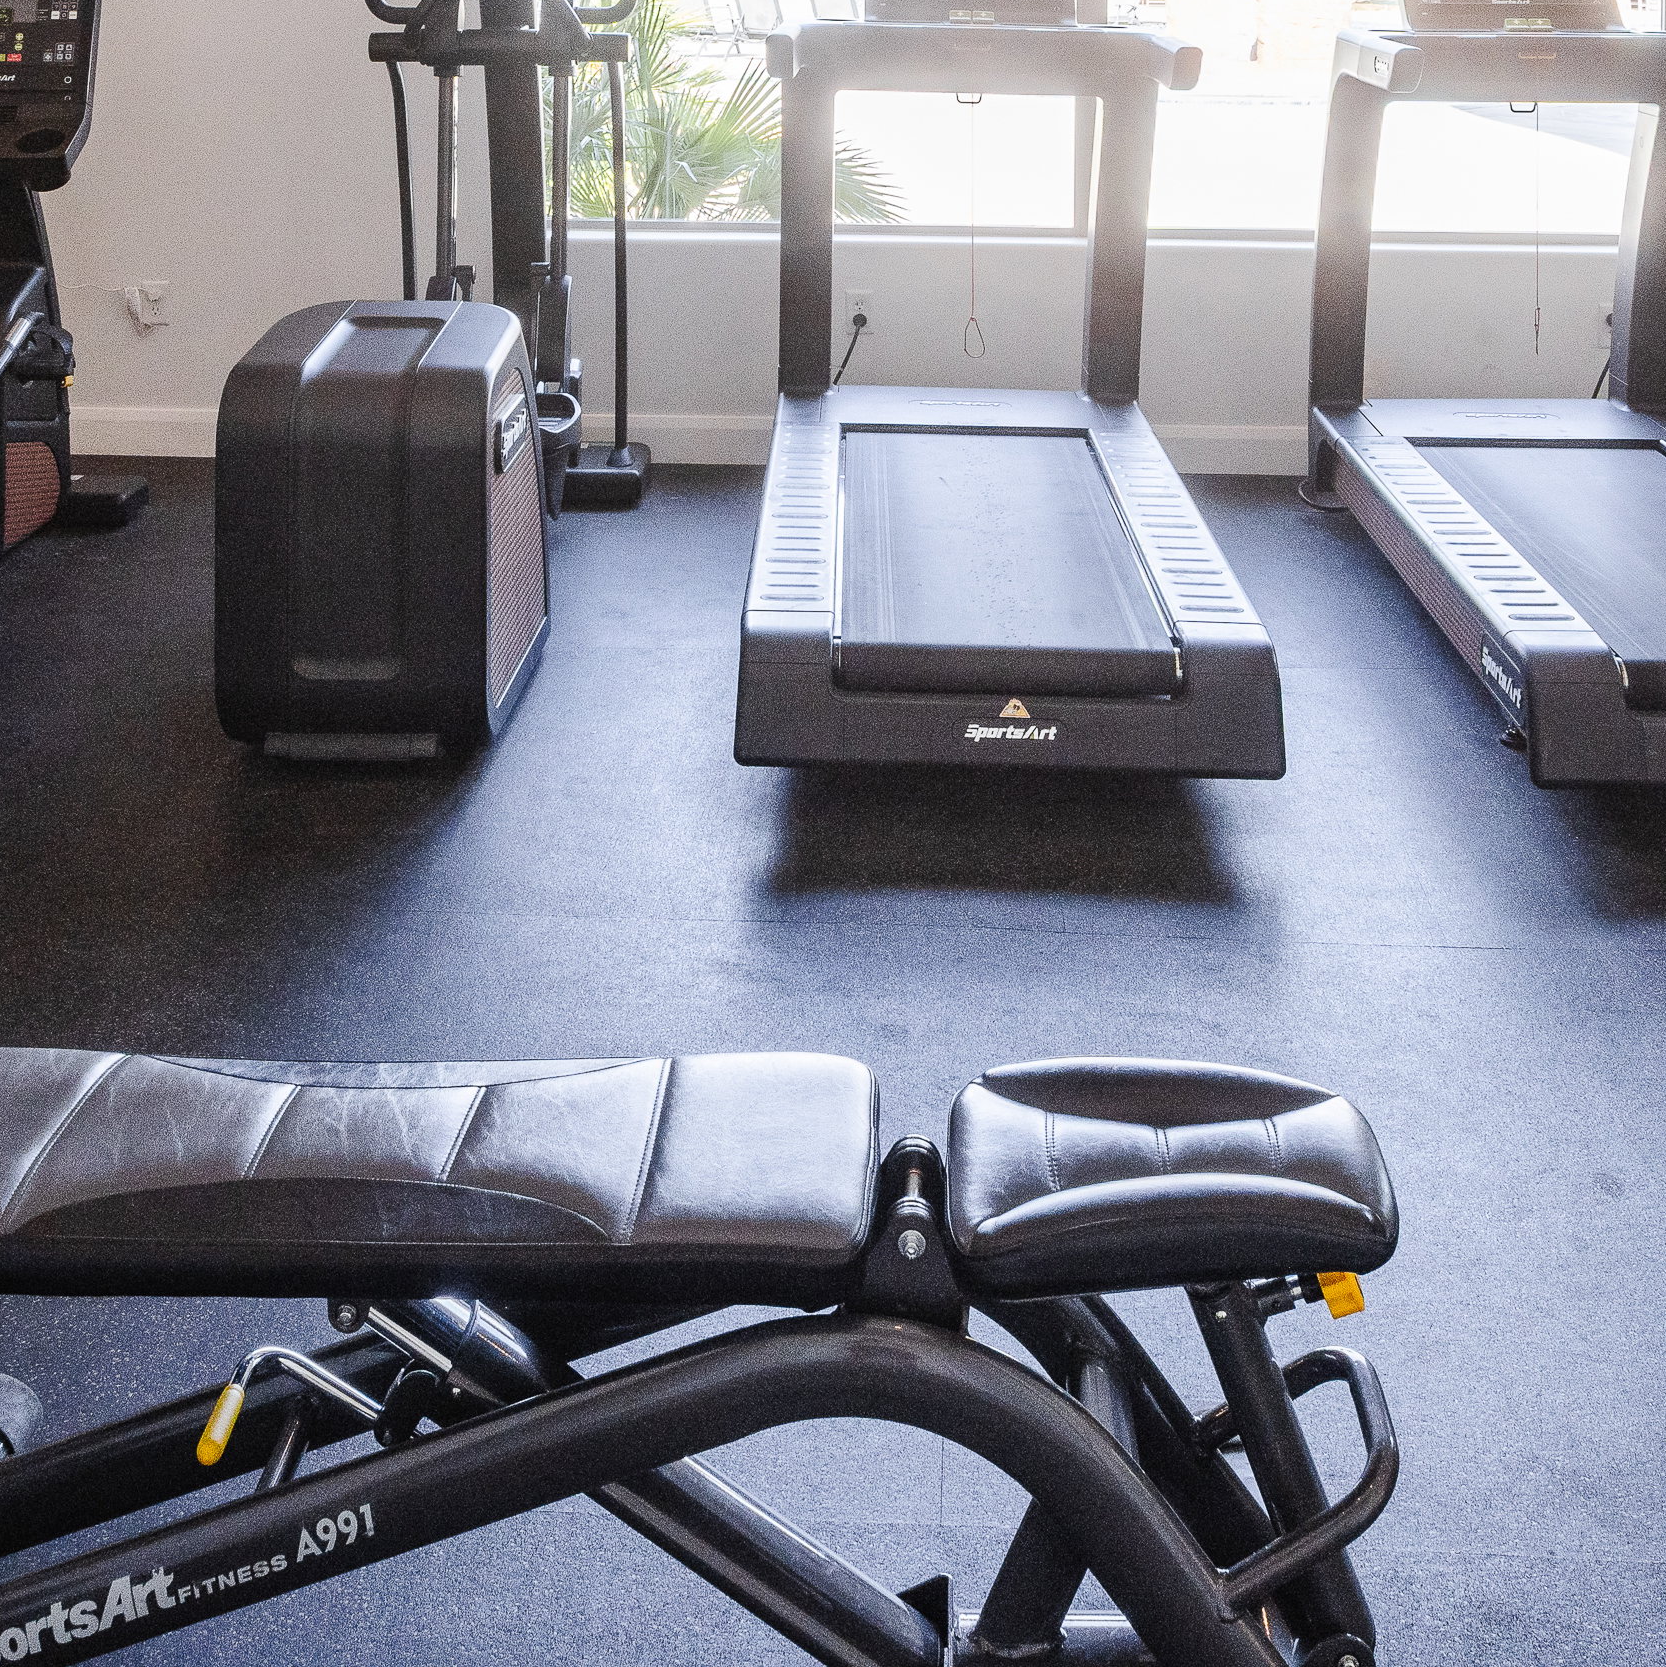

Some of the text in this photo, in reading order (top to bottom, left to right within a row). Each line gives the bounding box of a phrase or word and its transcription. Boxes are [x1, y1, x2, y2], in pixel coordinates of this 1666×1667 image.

[1481, 646, 1522, 709] SportsArt
[964, 724, 1057, 742] SportsArt
[177, 1553, 288, 1604] FITNESS
[296, 1503, 375, 1564] A991
